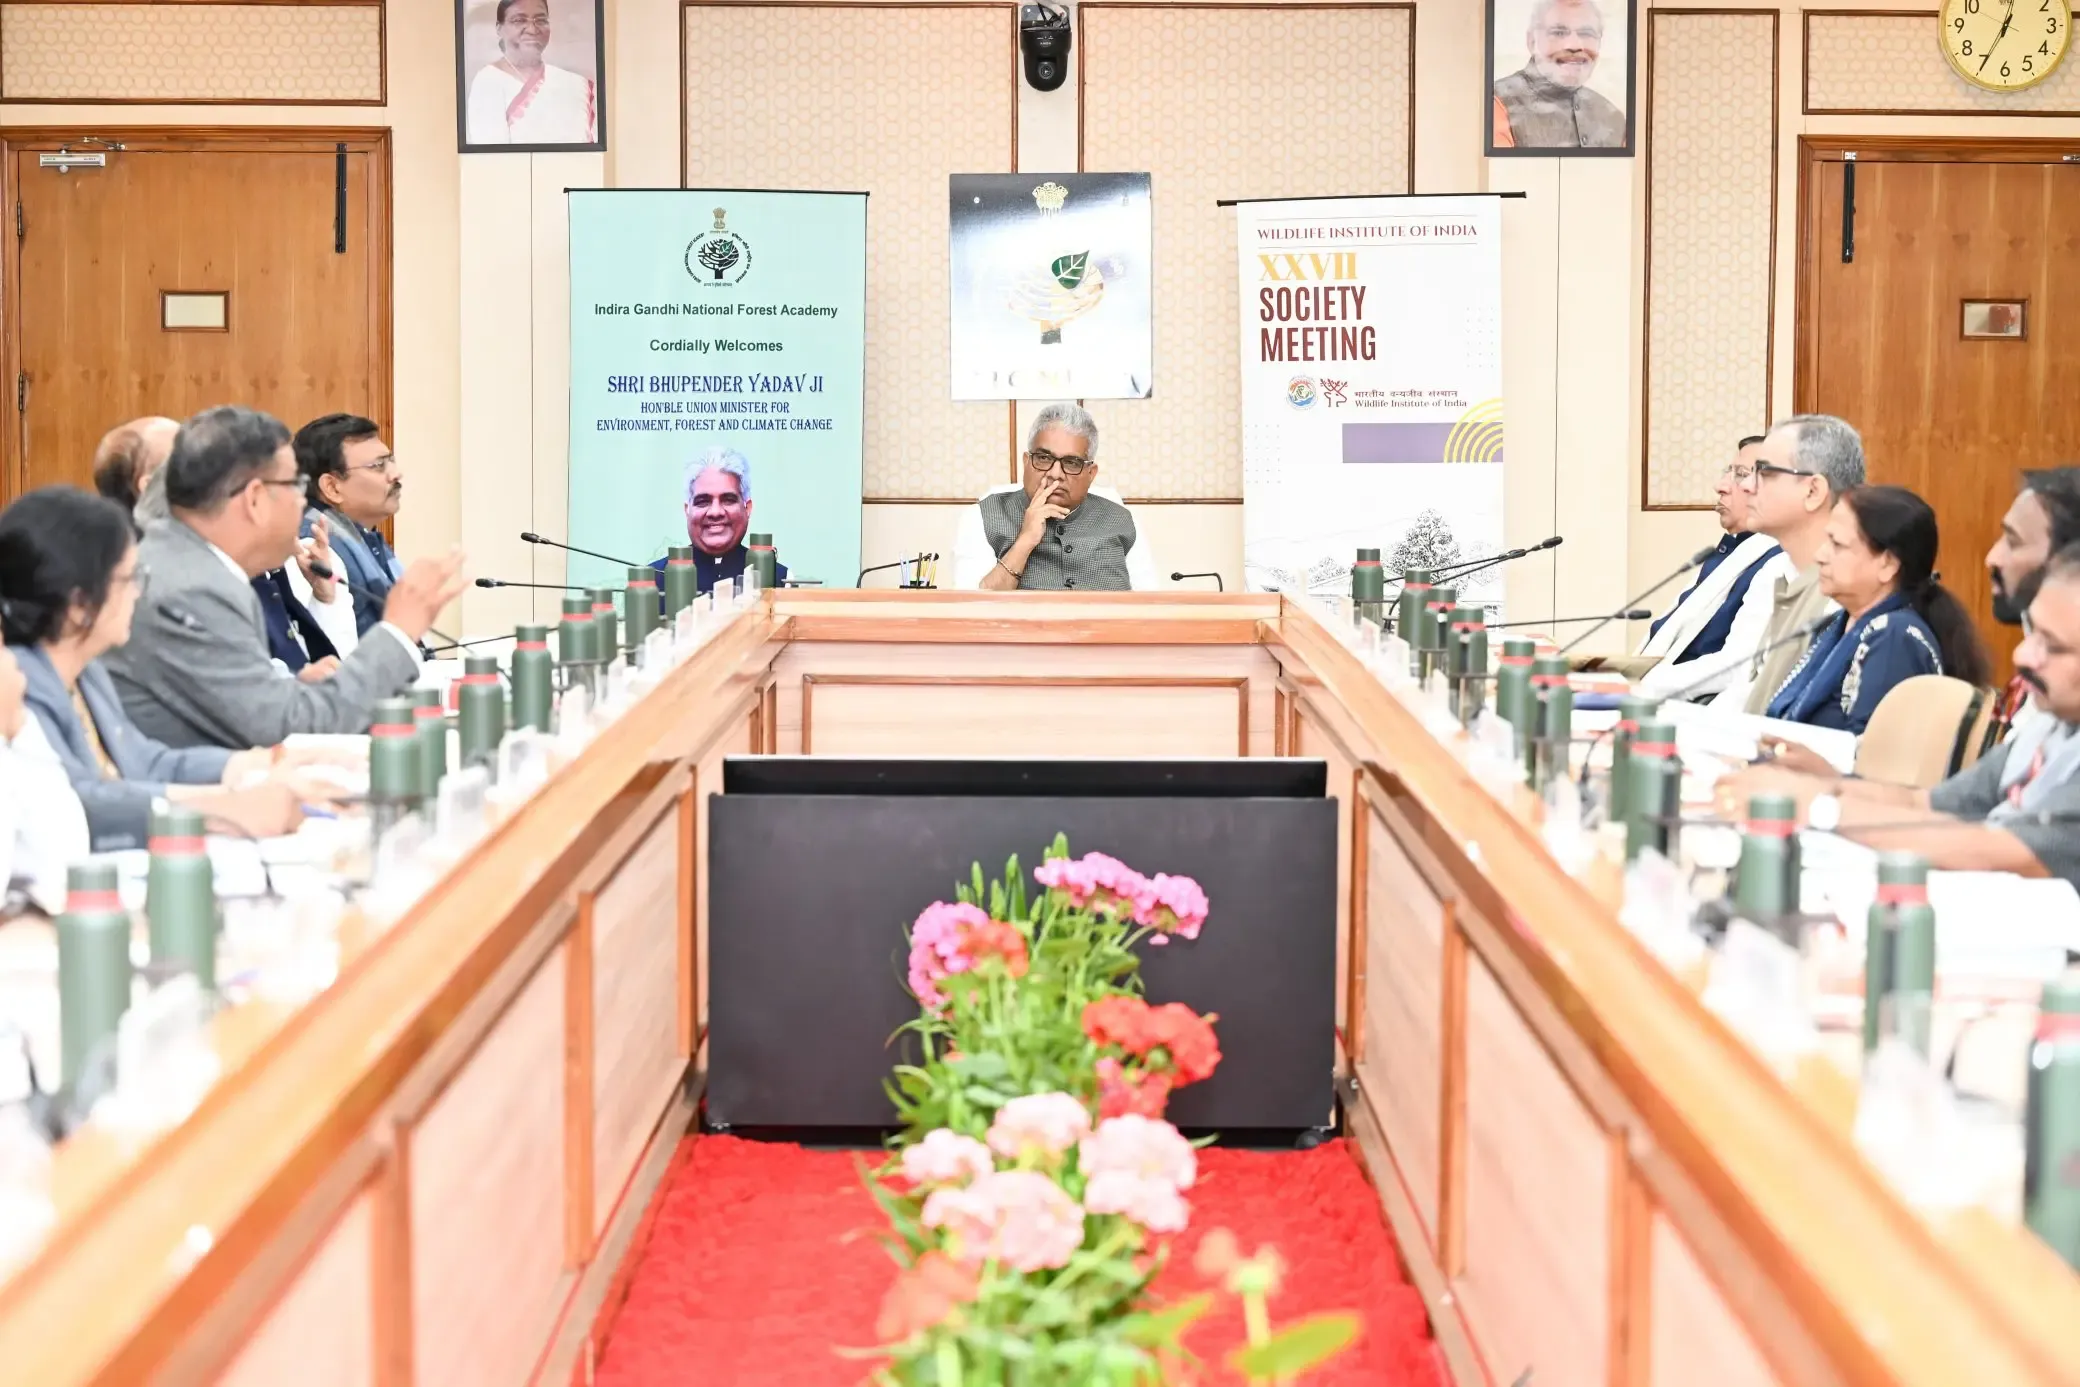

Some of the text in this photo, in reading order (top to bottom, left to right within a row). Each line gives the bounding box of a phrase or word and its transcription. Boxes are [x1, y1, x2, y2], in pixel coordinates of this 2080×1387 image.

[1964, 0, 1980, 14] 10
[1954, 17, 1965, 34] 9
[2046, 17, 2057, 34] 3
[1962, 40, 1972, 56] 8
[2038, 40, 2049, 56] 4
[1979, 54, 1990, 72] 7
[2000, 60, 2011, 77] 6
[2022, 55, 2033, 72] 5
[1257, 224, 1478, 241] WILDLIFE INSTITUTE OF INDIA
[1257, 252, 1358, 282] XXVII
[594, 303, 838, 319] Indira Gandhi National Forest Academy
[1259, 285, 1367, 322] SOCIETY
[649, 338, 784, 355] Cordially Welcomes
[1260, 325, 1376, 363] MEETING
[607, 372, 824, 394] SHRI BHUPENDER YADAV JI
[640, 401, 790, 414] HON'BLE UNION MINISTER FOR
[1355, 399, 1467, 408] Wildlife Institute of India
[596, 418, 833, 432] ENVIRONMENT, FOREST AND CLIMATE CHANGE
